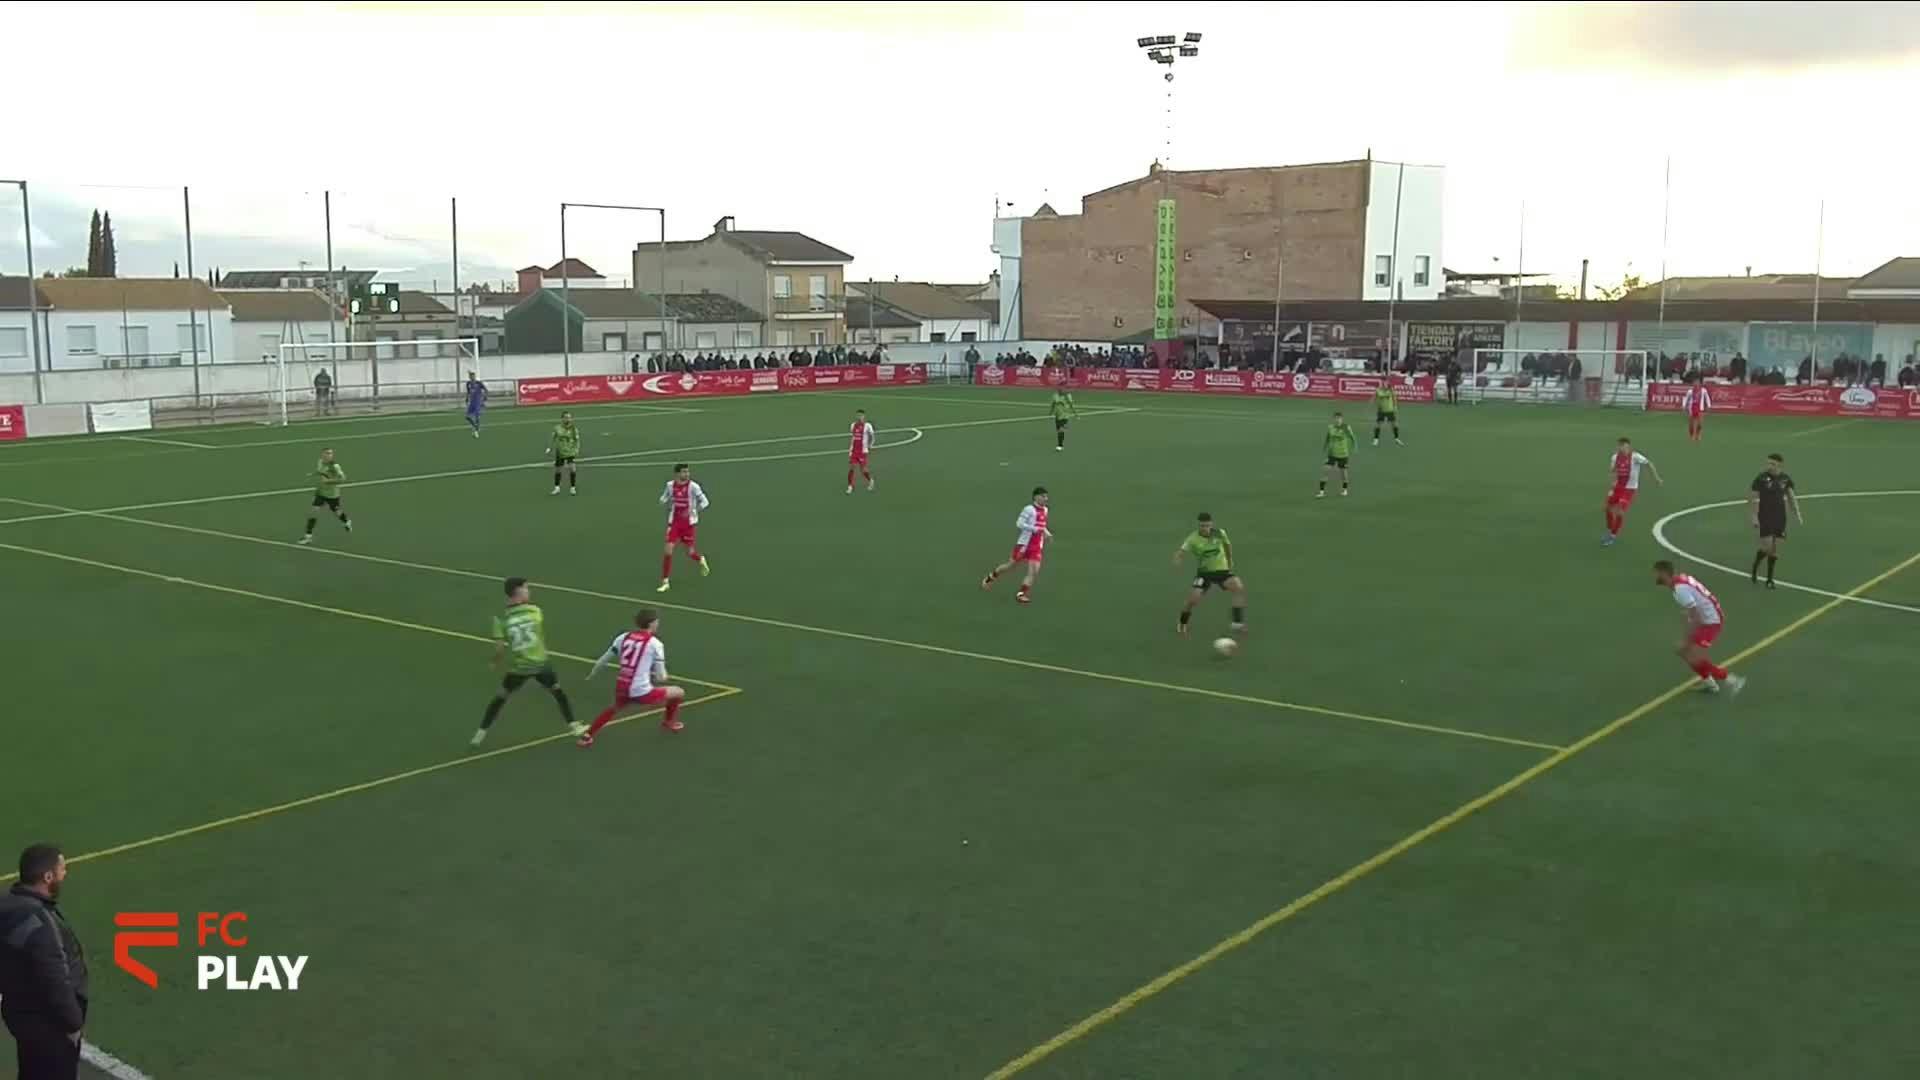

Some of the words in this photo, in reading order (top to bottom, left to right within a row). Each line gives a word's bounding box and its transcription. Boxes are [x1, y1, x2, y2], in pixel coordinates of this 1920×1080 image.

[1410, 325, 1455, 335] TIENDAS
[1409, 336, 1455, 346] FACTORY
[508, 622, 537, 651] 23
[621, 640, 643, 667] 21
